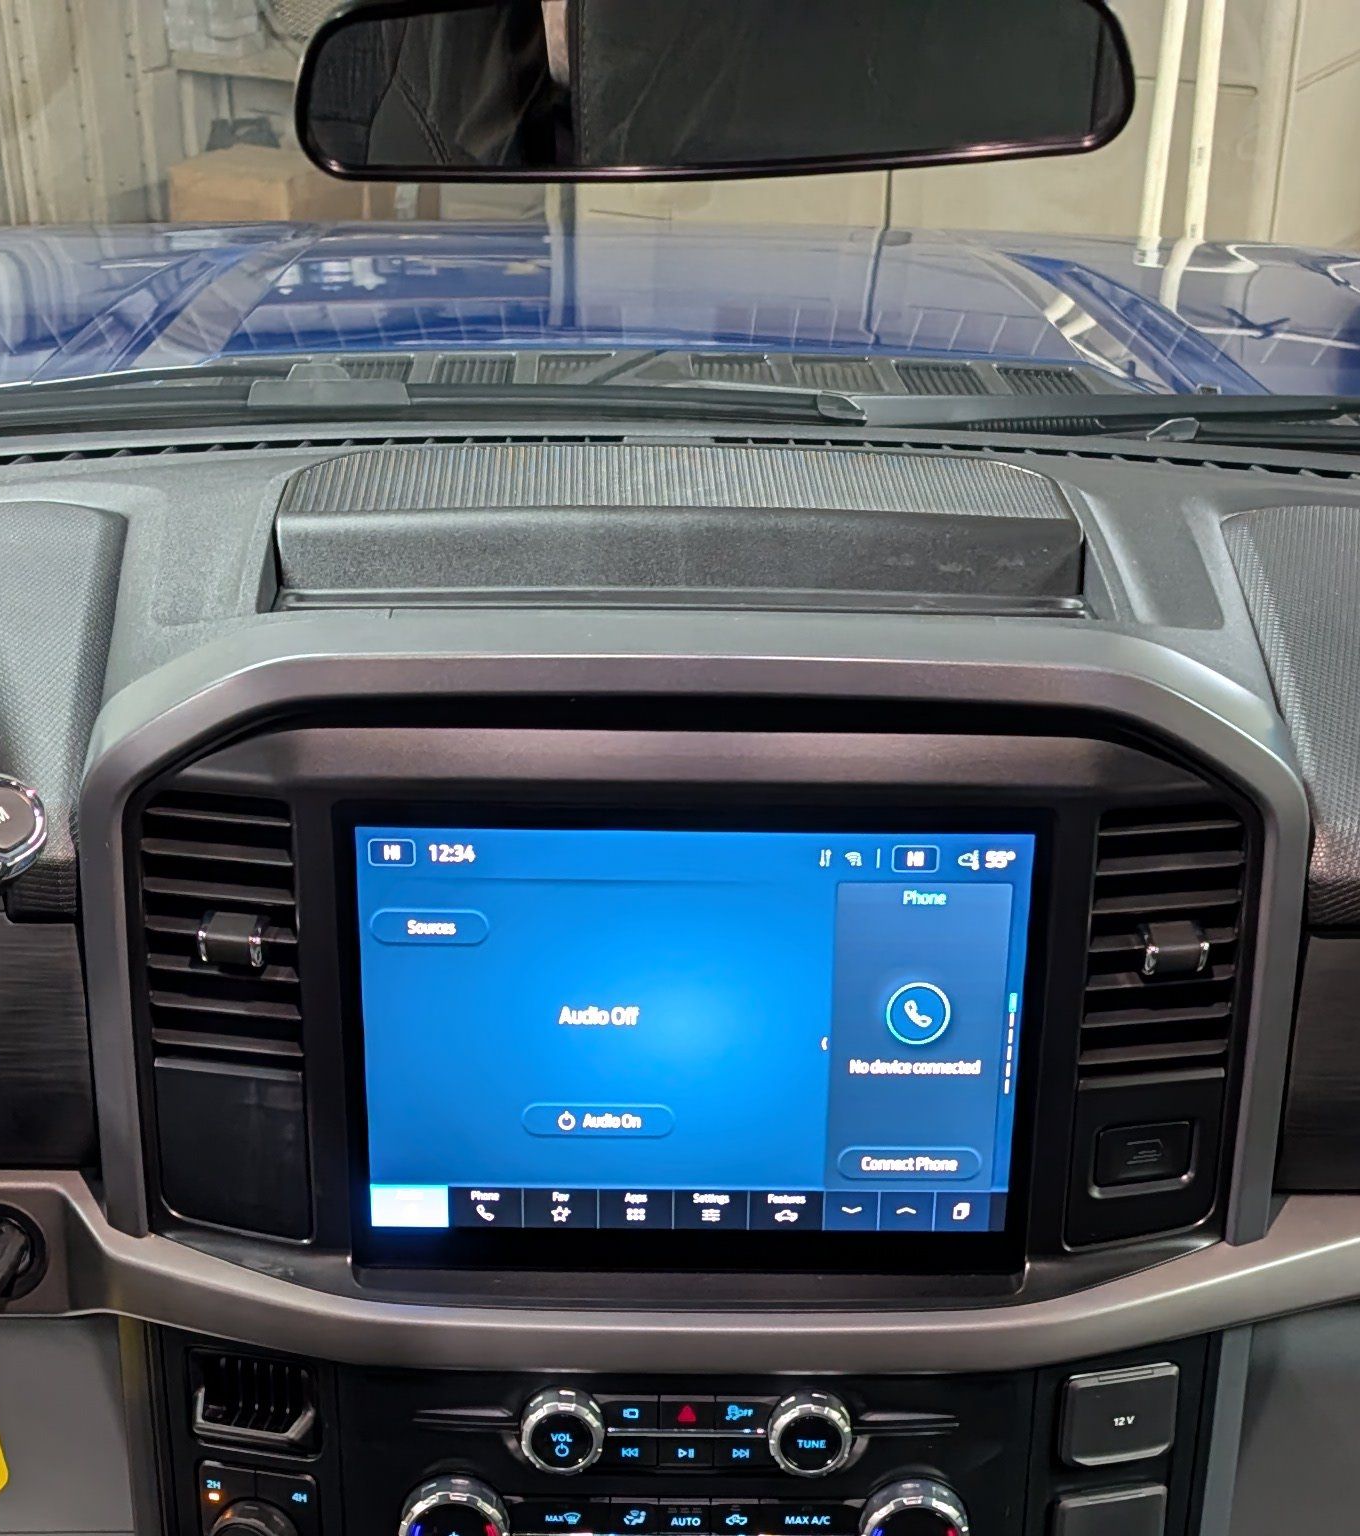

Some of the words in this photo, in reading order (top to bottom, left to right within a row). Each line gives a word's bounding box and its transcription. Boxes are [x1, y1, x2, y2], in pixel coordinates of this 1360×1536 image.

[428, 844, 476, 863] 12:34
[902, 890, 947, 906] Phone
[407, 919, 457, 936] Sources
[558, 1006, 610, 1026] Audio
[610, 1006, 640, 1026] Off
[849, 1059, 870, 1075] No
[869, 1058, 912, 1075] device
[912, 1059, 982, 1075] connected
[582, 1113, 621, 1129] Audio
[621, 1113, 642, 1129] On
[861, 1156, 915, 1172] Connect
[915, 1156, 958, 1172] Phone
[470, 1190, 500, 1201] Phone
[624, 1192, 648, 1205] Apps
[692, 1192, 730, 1206] Settings
[767, 1193, 806, 1205] Features
[551, 1432, 573, 1443] VOL
[797, 1438, 827, 1449] TUNE
[206, 1479, 221, 1490] 2H
[292, 1492, 308, 1504] 4H
[545, 1514, 564, 1523] MAX
[671, 1516, 702, 1527] AUTO
[785, 1515, 810, 1525] MAX
[810, 1515, 831, 1526] A/C
